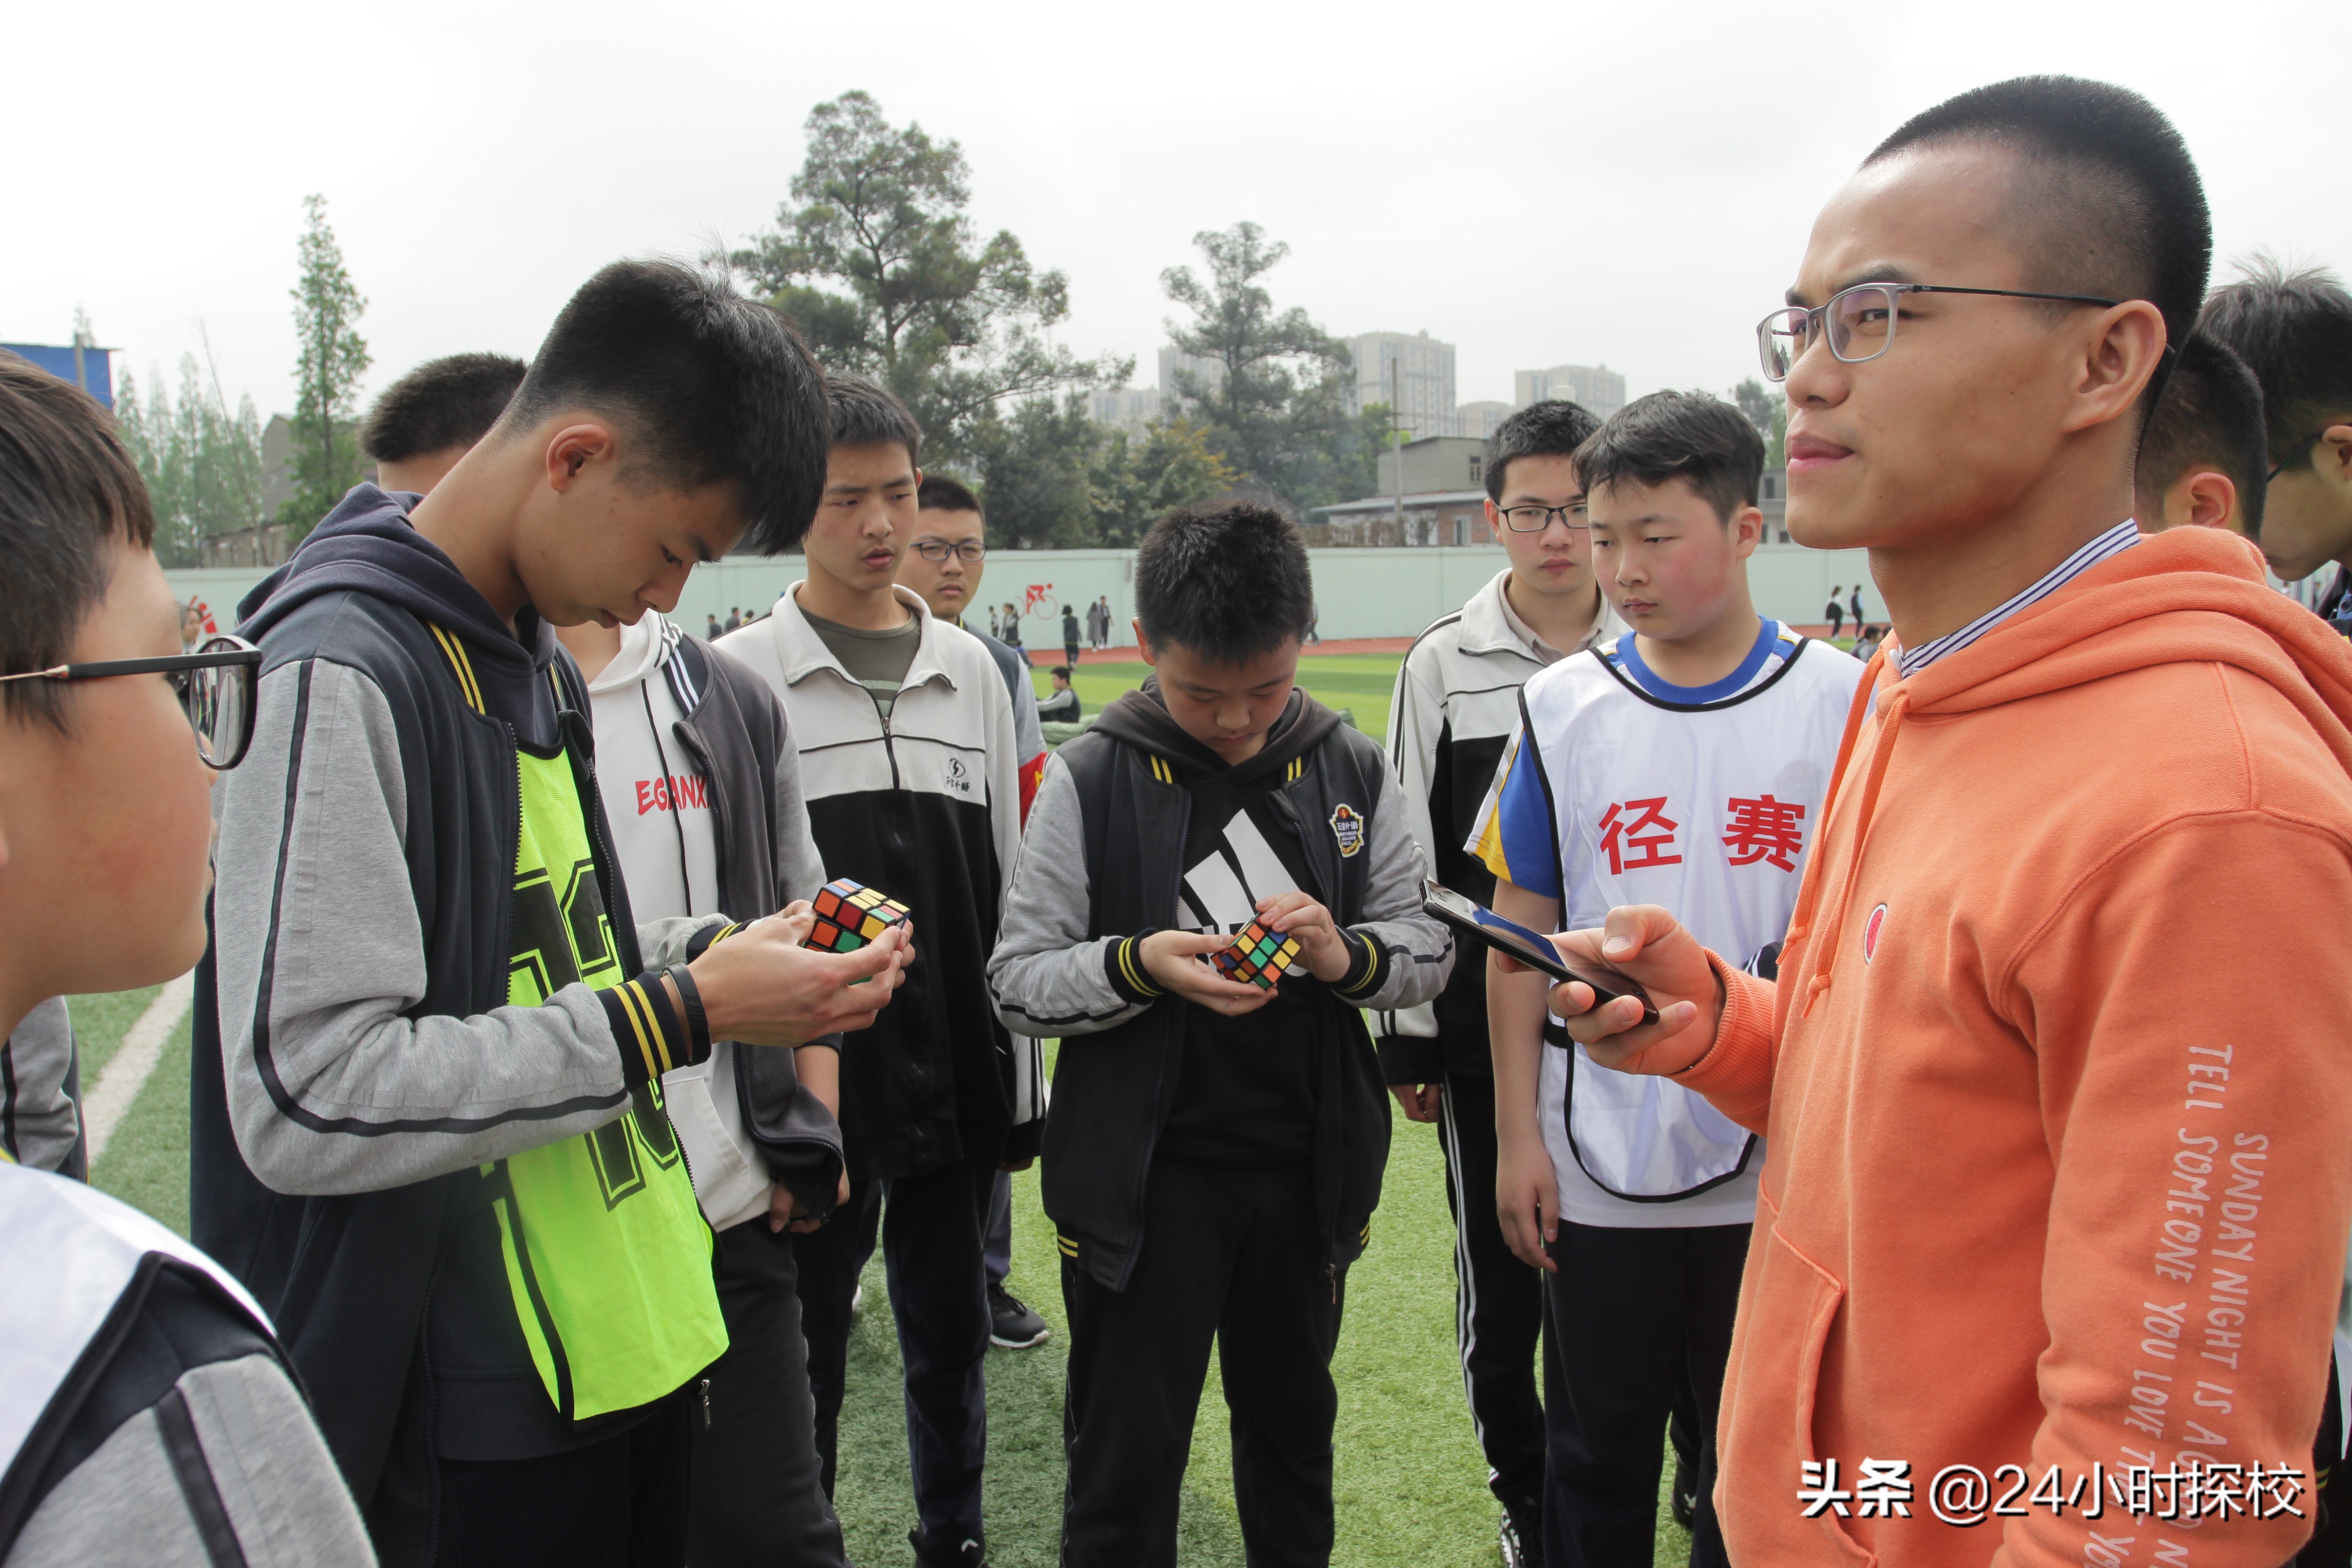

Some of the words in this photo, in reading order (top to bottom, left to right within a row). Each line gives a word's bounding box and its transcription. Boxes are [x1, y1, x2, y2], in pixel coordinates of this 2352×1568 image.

[635, 774, 710, 816] EGANX
[1599, 794, 1805, 875] 径赛
[2185, 1044, 2232, 1109] TELL
[2155, 1127, 2219, 1284] SOMEONE
[2211, 1133, 2269, 1261] SUNDAY
[2141, 1302, 2187, 1360] YOU
[2200, 1268, 2249, 1370] NIGHT
[2124, 1369, 2172, 1439] LOVE
[2193, 1381, 2233, 1414] IS
[2183, 1420, 2228, 1445] A
[2082, 1531, 2136, 1568] YO
